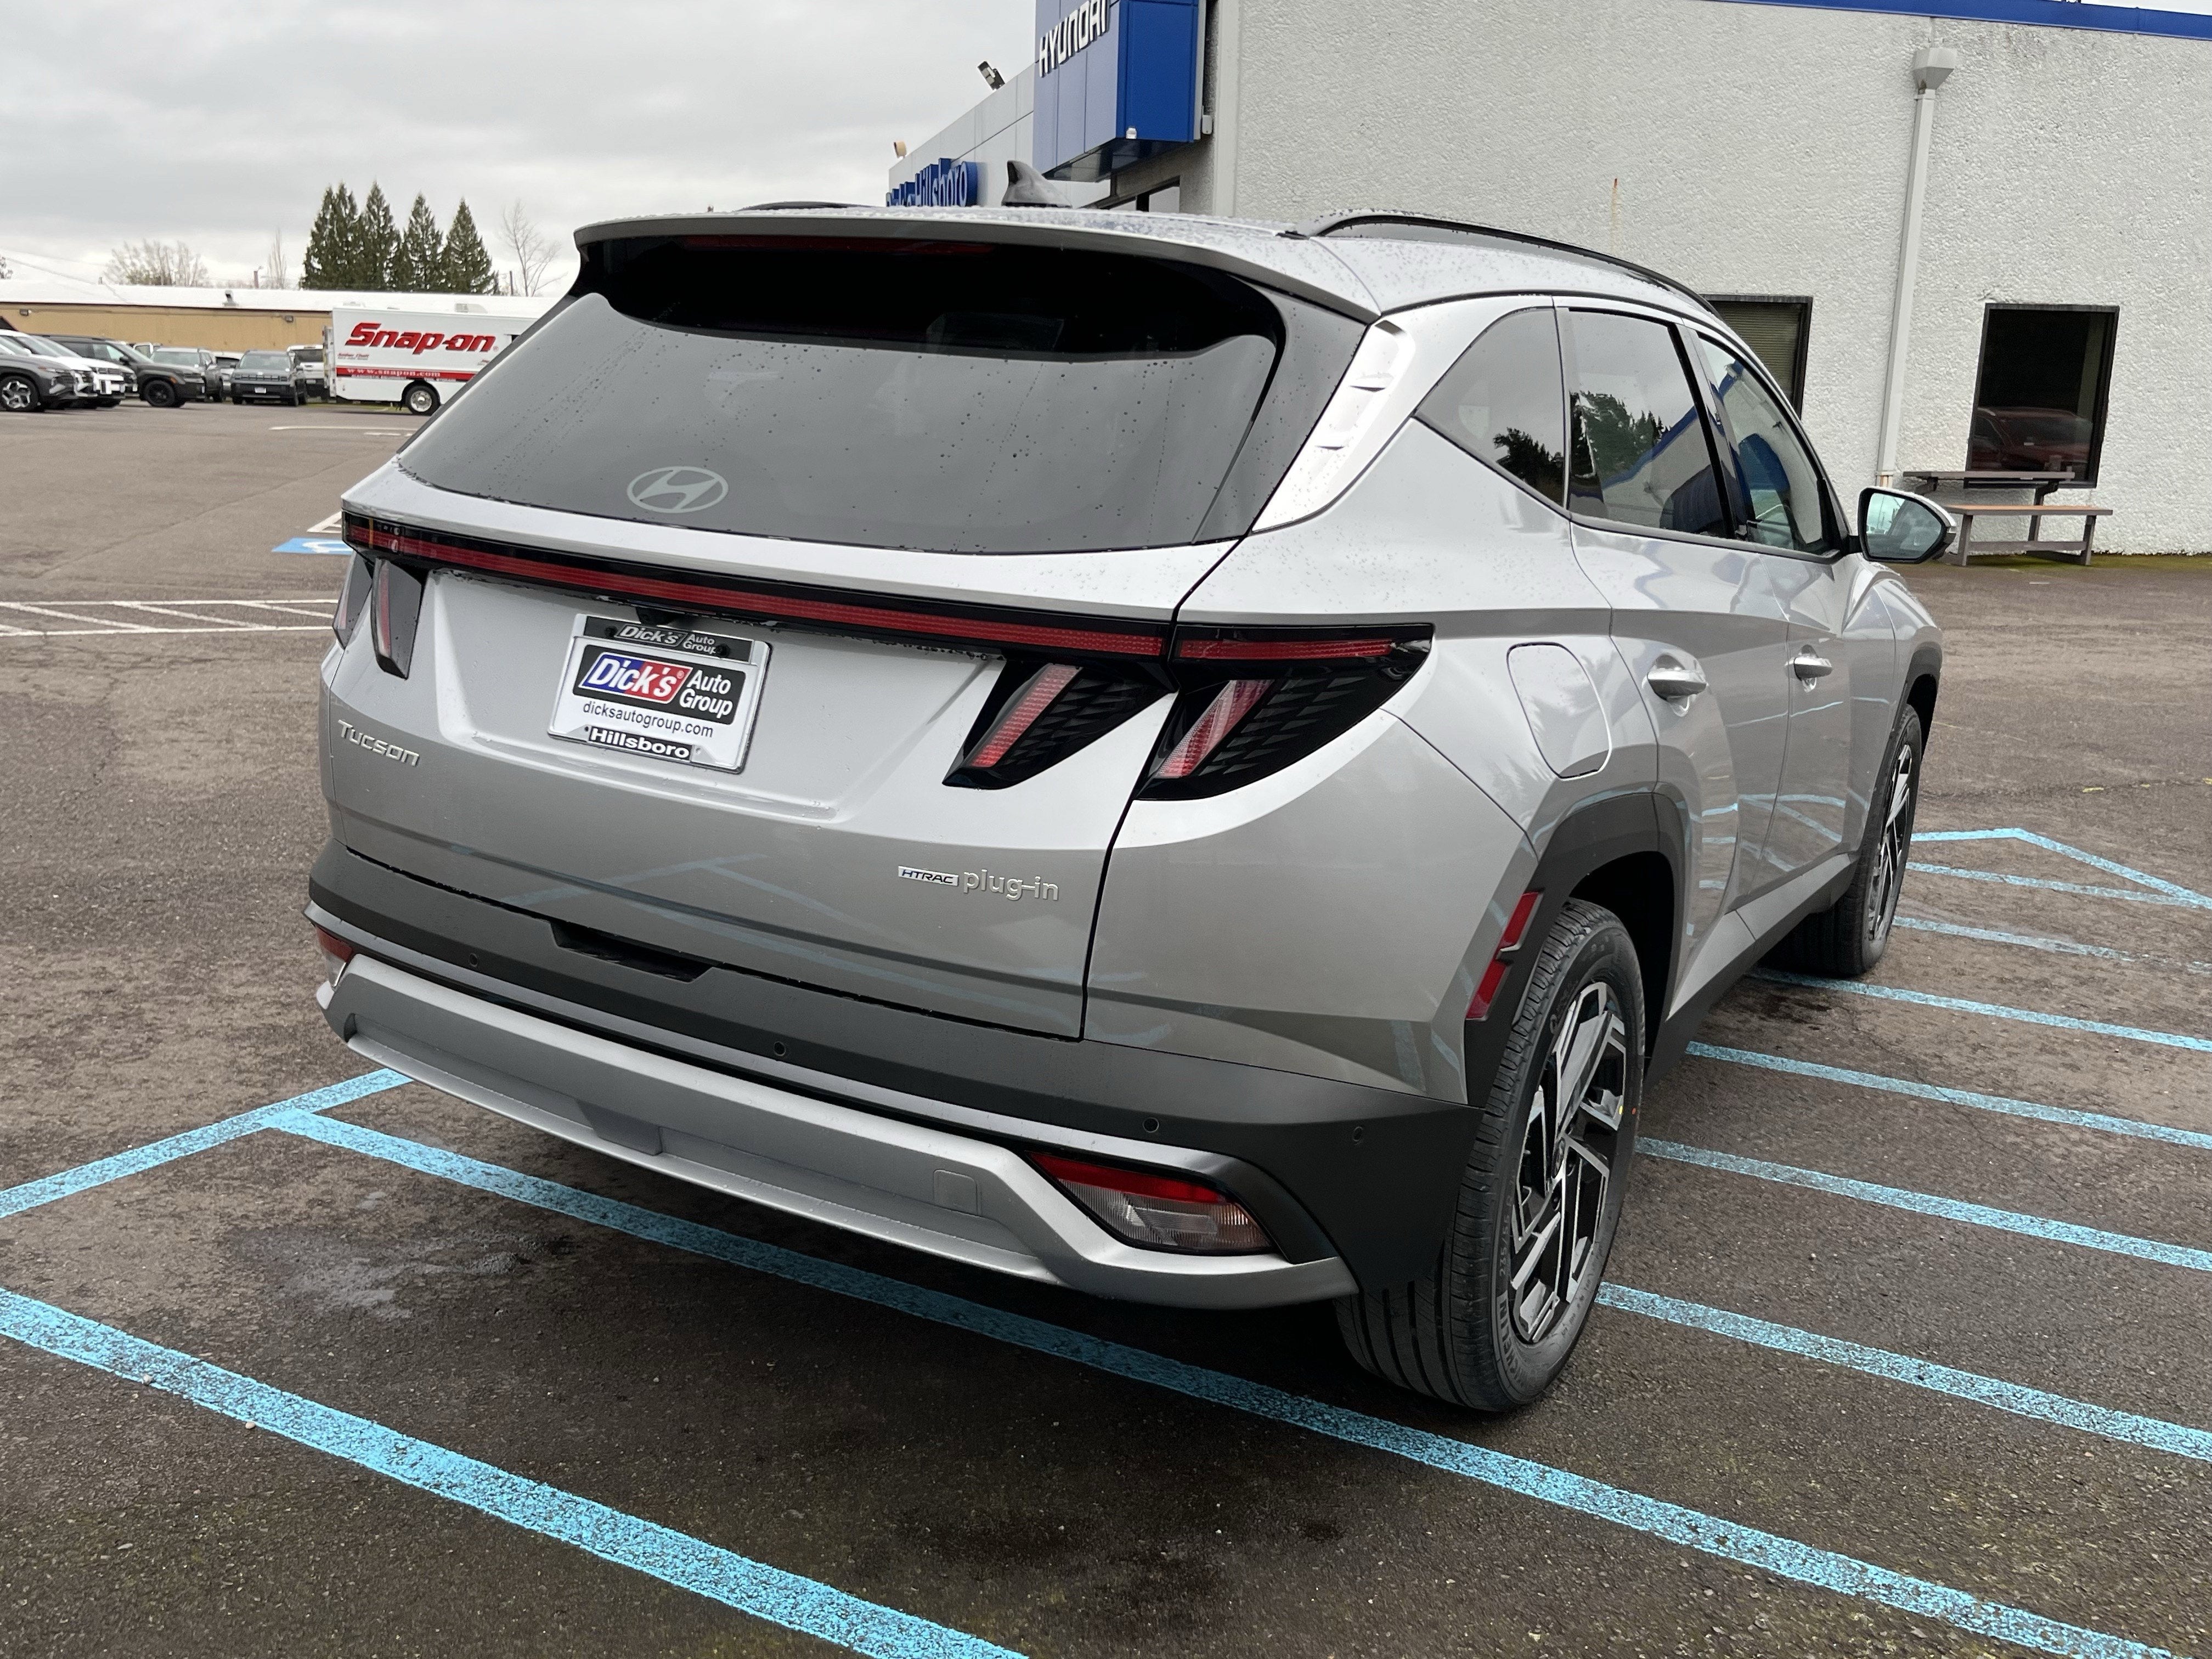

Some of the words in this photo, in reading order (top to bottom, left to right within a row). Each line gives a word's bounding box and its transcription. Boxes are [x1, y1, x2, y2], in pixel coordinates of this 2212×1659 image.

[1039, 0, 1107, 77] HYUNDAI
[345, 323, 496, 355] Snap-on
[620, 625, 680, 645] Dick's
[687, 634, 715, 645] Auto
[588, 658, 677, 698] Dick's
[687, 670, 731, 695] Auto
[583, 701, 713, 738] dicksautogroup.com
[679, 689, 733, 719] Group
[590, 727, 690, 758] Hillsboro
[901, 869, 953, 884] HTRAC
[963, 869, 1059, 901] plug-in
